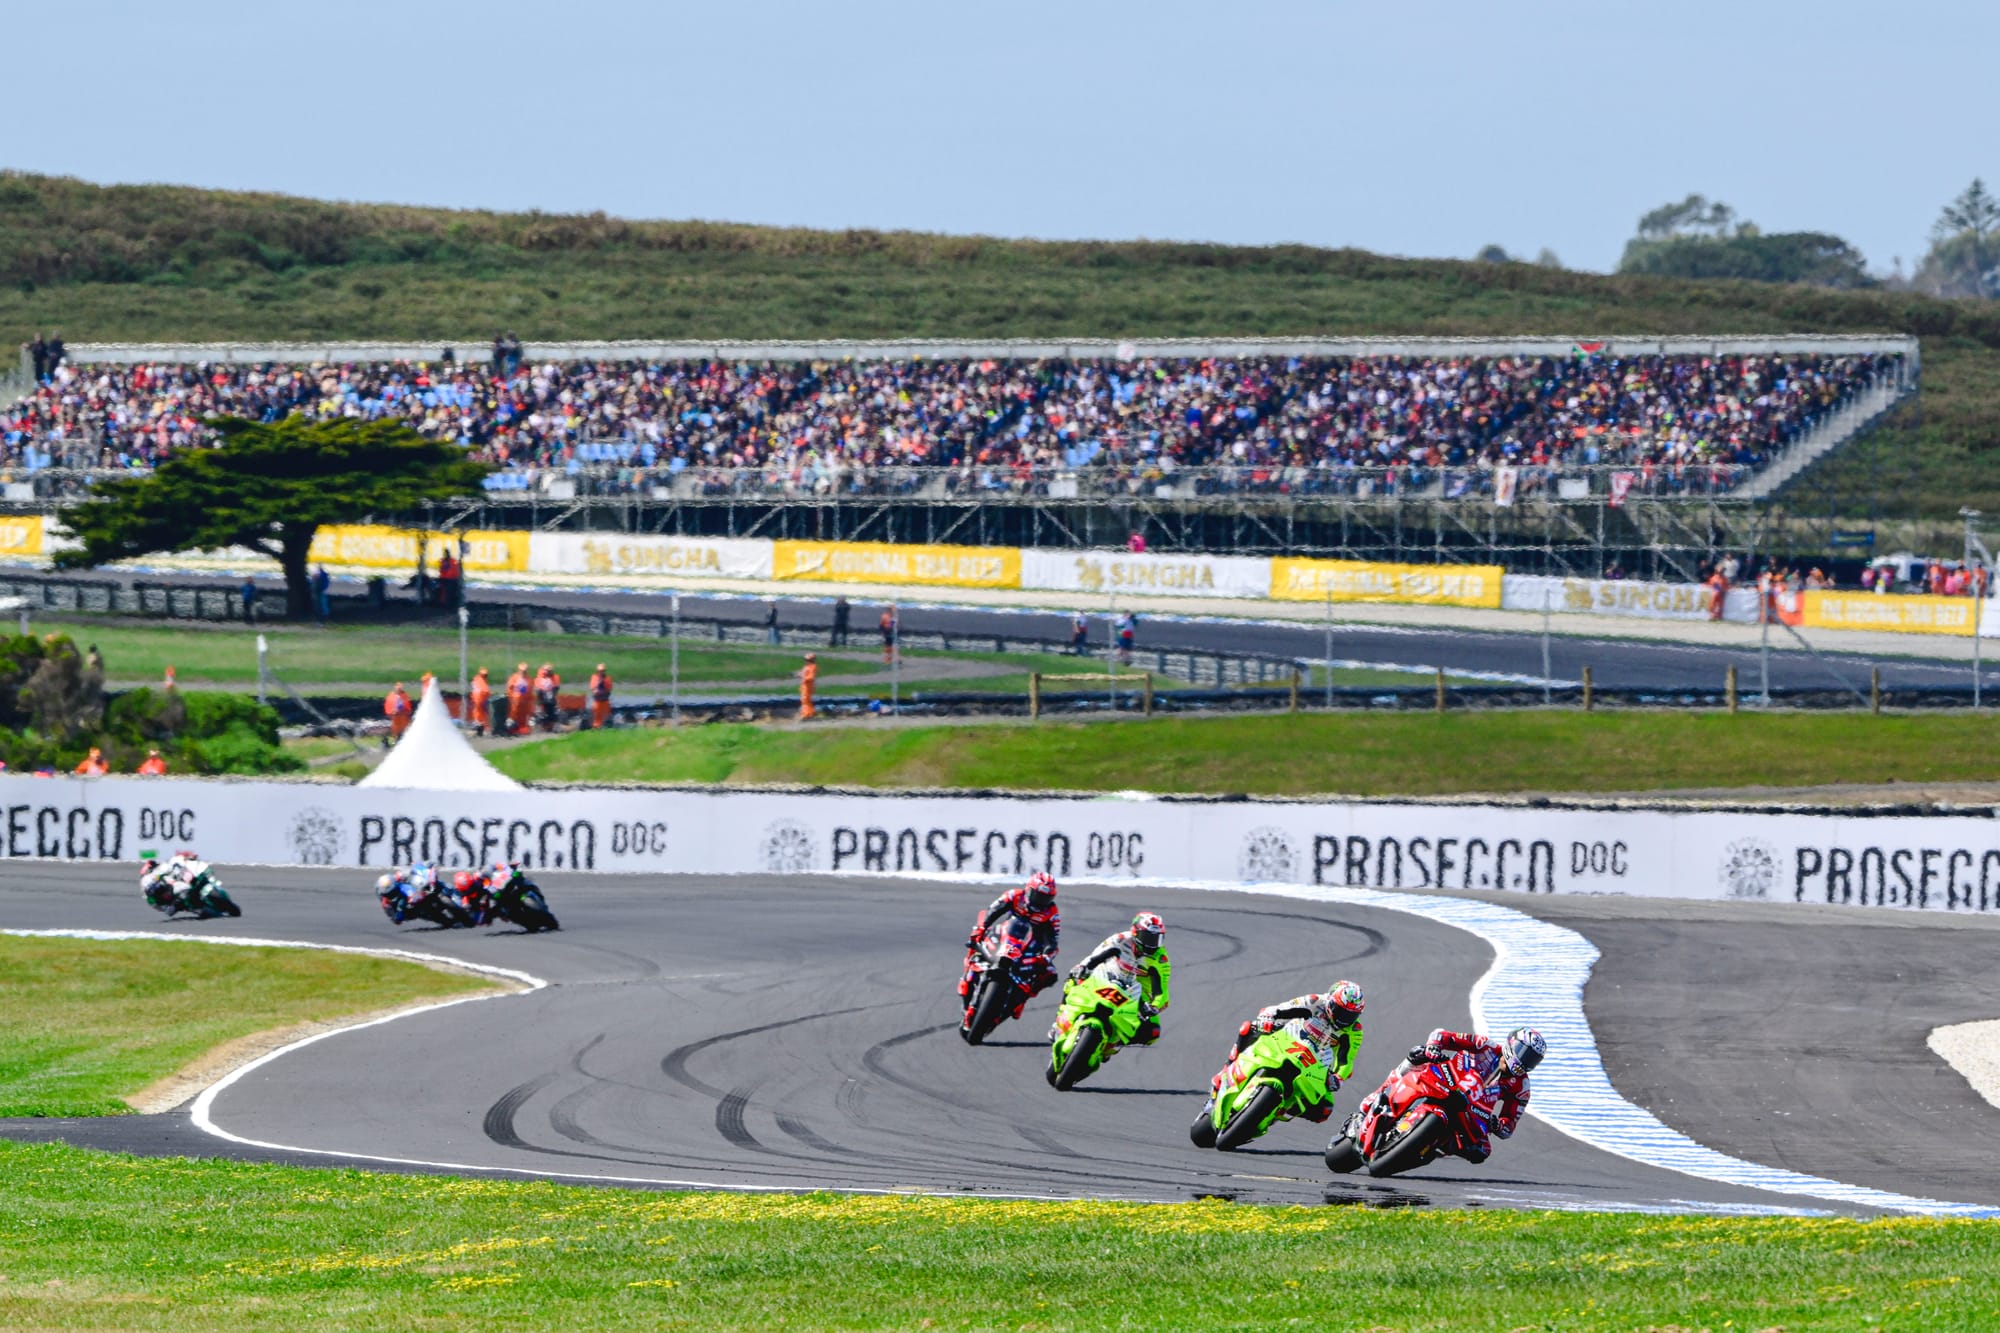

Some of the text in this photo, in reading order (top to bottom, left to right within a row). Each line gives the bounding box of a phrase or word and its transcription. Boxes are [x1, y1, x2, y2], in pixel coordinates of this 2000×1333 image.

[617, 544, 721, 571] SINGHA
[830, 550, 909, 576] ORIGINAL
[1109, 562, 1215, 588] SINGHA
[0, 805, 195, 859] ECCO DOC
[359, 816, 667, 869] PROSECCO DOC
[832, 826, 1144, 876] PROSECCO DOC
[1313, 834, 1628, 893] PROSECCO DOC
[1096, 988, 1128, 1007] 49
[1285, 1041, 1318, 1068] 72
[1440, 1063, 1455, 1087] Lenovo
[1458, 1073, 1484, 1102] 23
[1470, 1104, 1490, 1120] Lenovo
